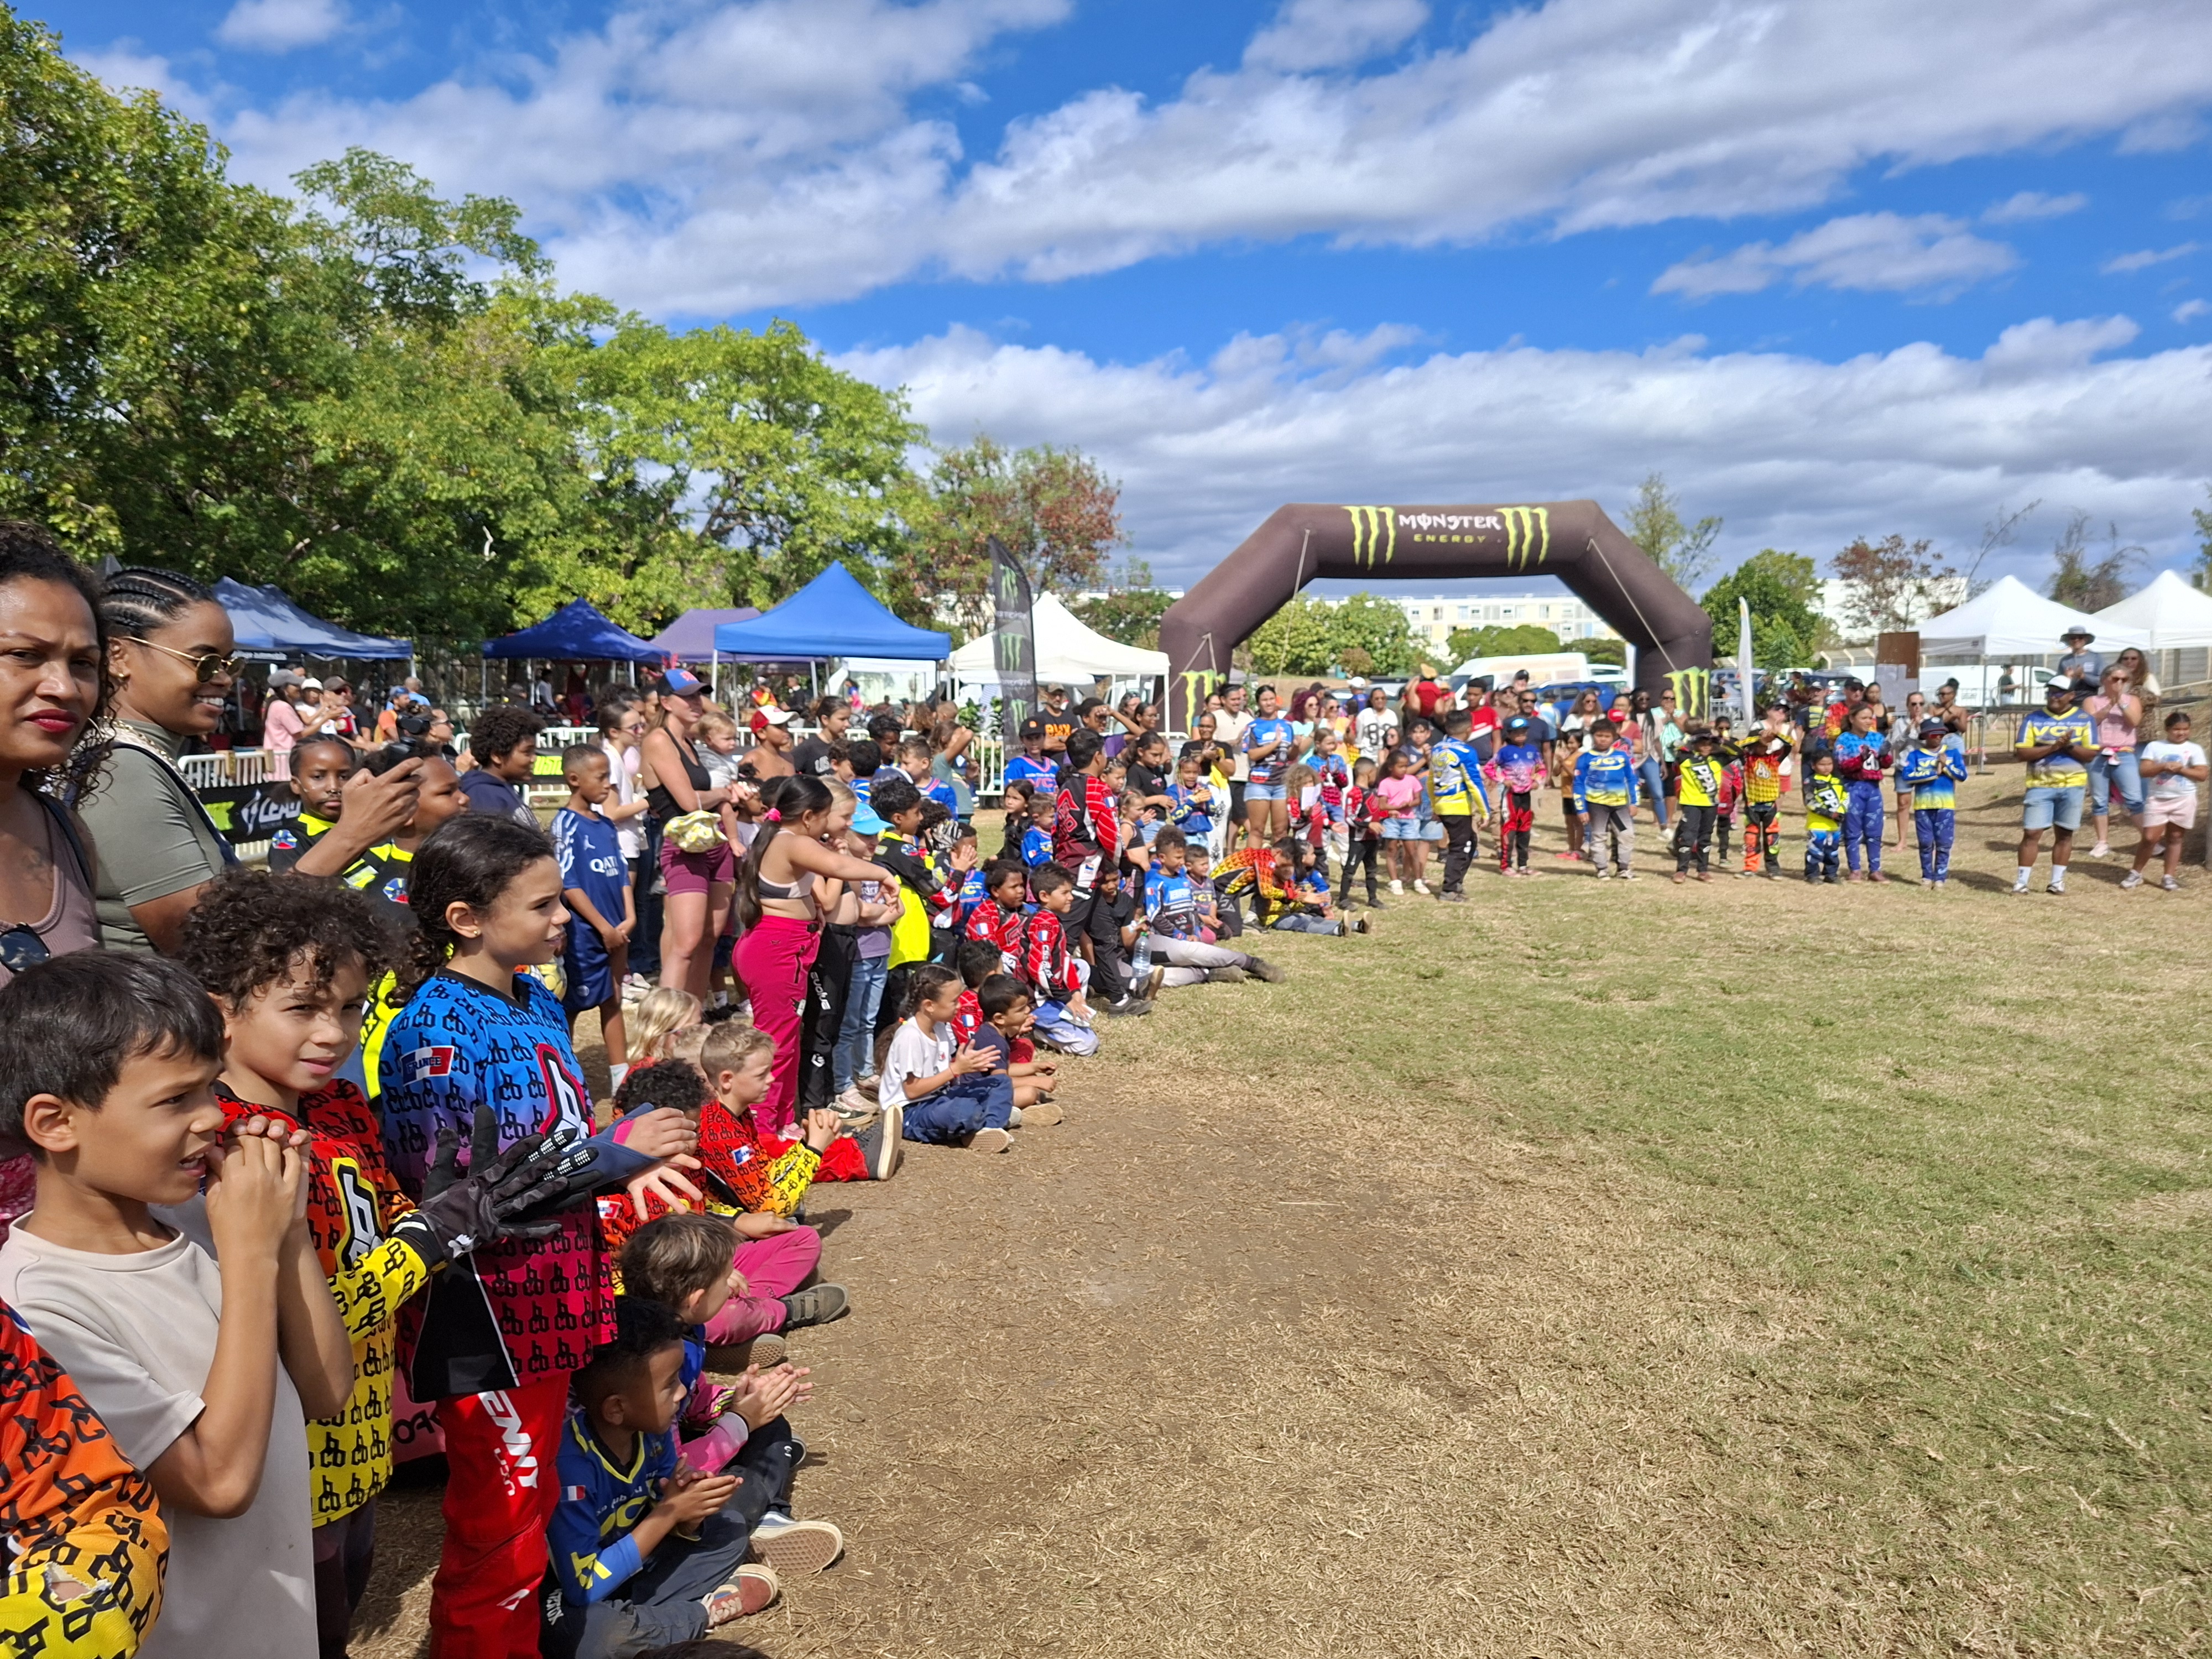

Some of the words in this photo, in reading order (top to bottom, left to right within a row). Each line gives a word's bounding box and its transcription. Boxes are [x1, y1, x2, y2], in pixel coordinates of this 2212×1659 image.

[1399, 513, 1502, 531] MONSTER
[1413, 534, 1486, 544] ENERGY
[2033, 725, 2083, 737] VCT
[406, 1056, 442, 1074] FRANCE
